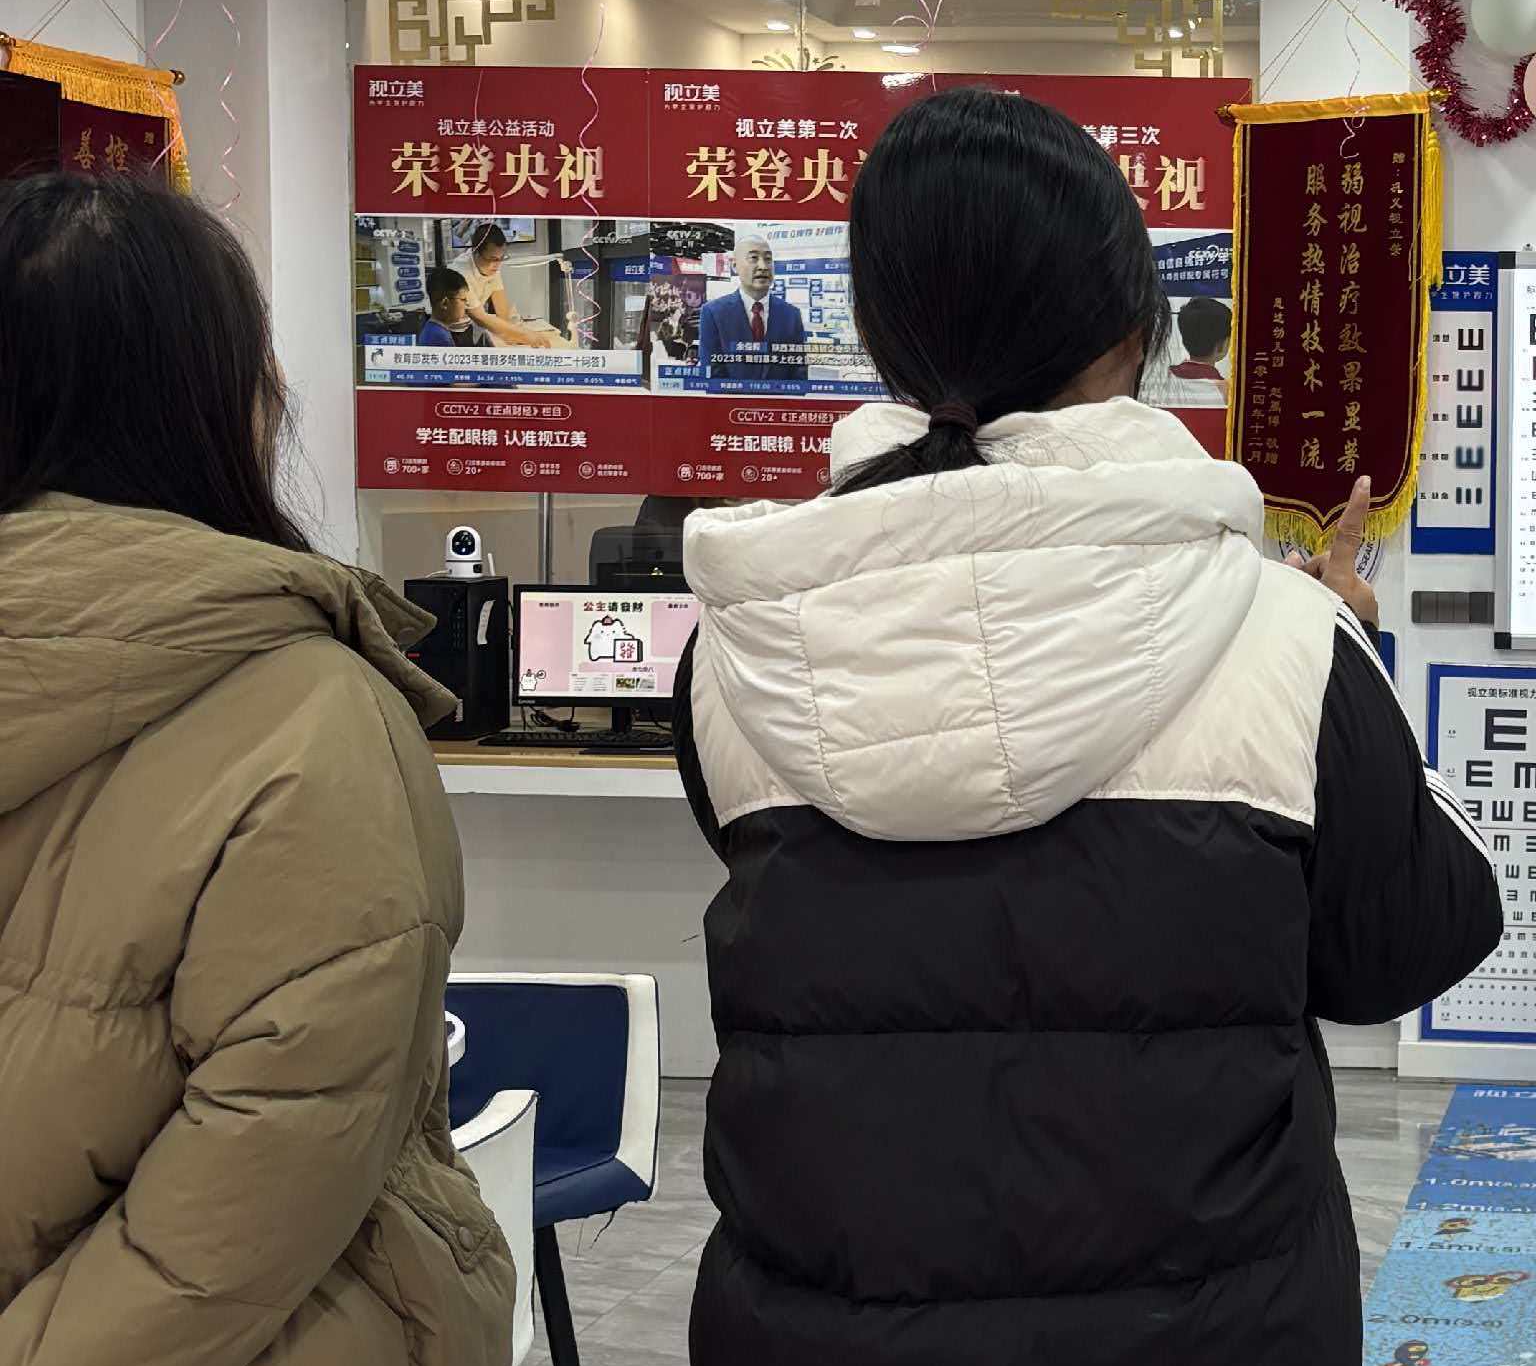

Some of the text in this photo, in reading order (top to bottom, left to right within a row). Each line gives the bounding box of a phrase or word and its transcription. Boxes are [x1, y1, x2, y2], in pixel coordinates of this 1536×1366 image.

[369, 80, 423, 97] 视立美
[664, 84, 720, 101] 视立美
[437, 119, 554, 137] 视立美公益活动
[736, 119, 858, 139] 视立美第二次
[391, 142, 604, 199] 荣登央视
[686, 146, 868, 203] 荣登央
[1298, 163, 1329, 472] 服务热情技术一流
[1336, 161, 1368, 474] 弱视治疗效果显著
[443, 404, 479, 416] CCTV-2
[738, 411, 775, 423] CCTV-2
[416, 427, 588, 448] 学生配眼镜 认准视立美
[710, 435, 794, 454] 学生配眼镜
